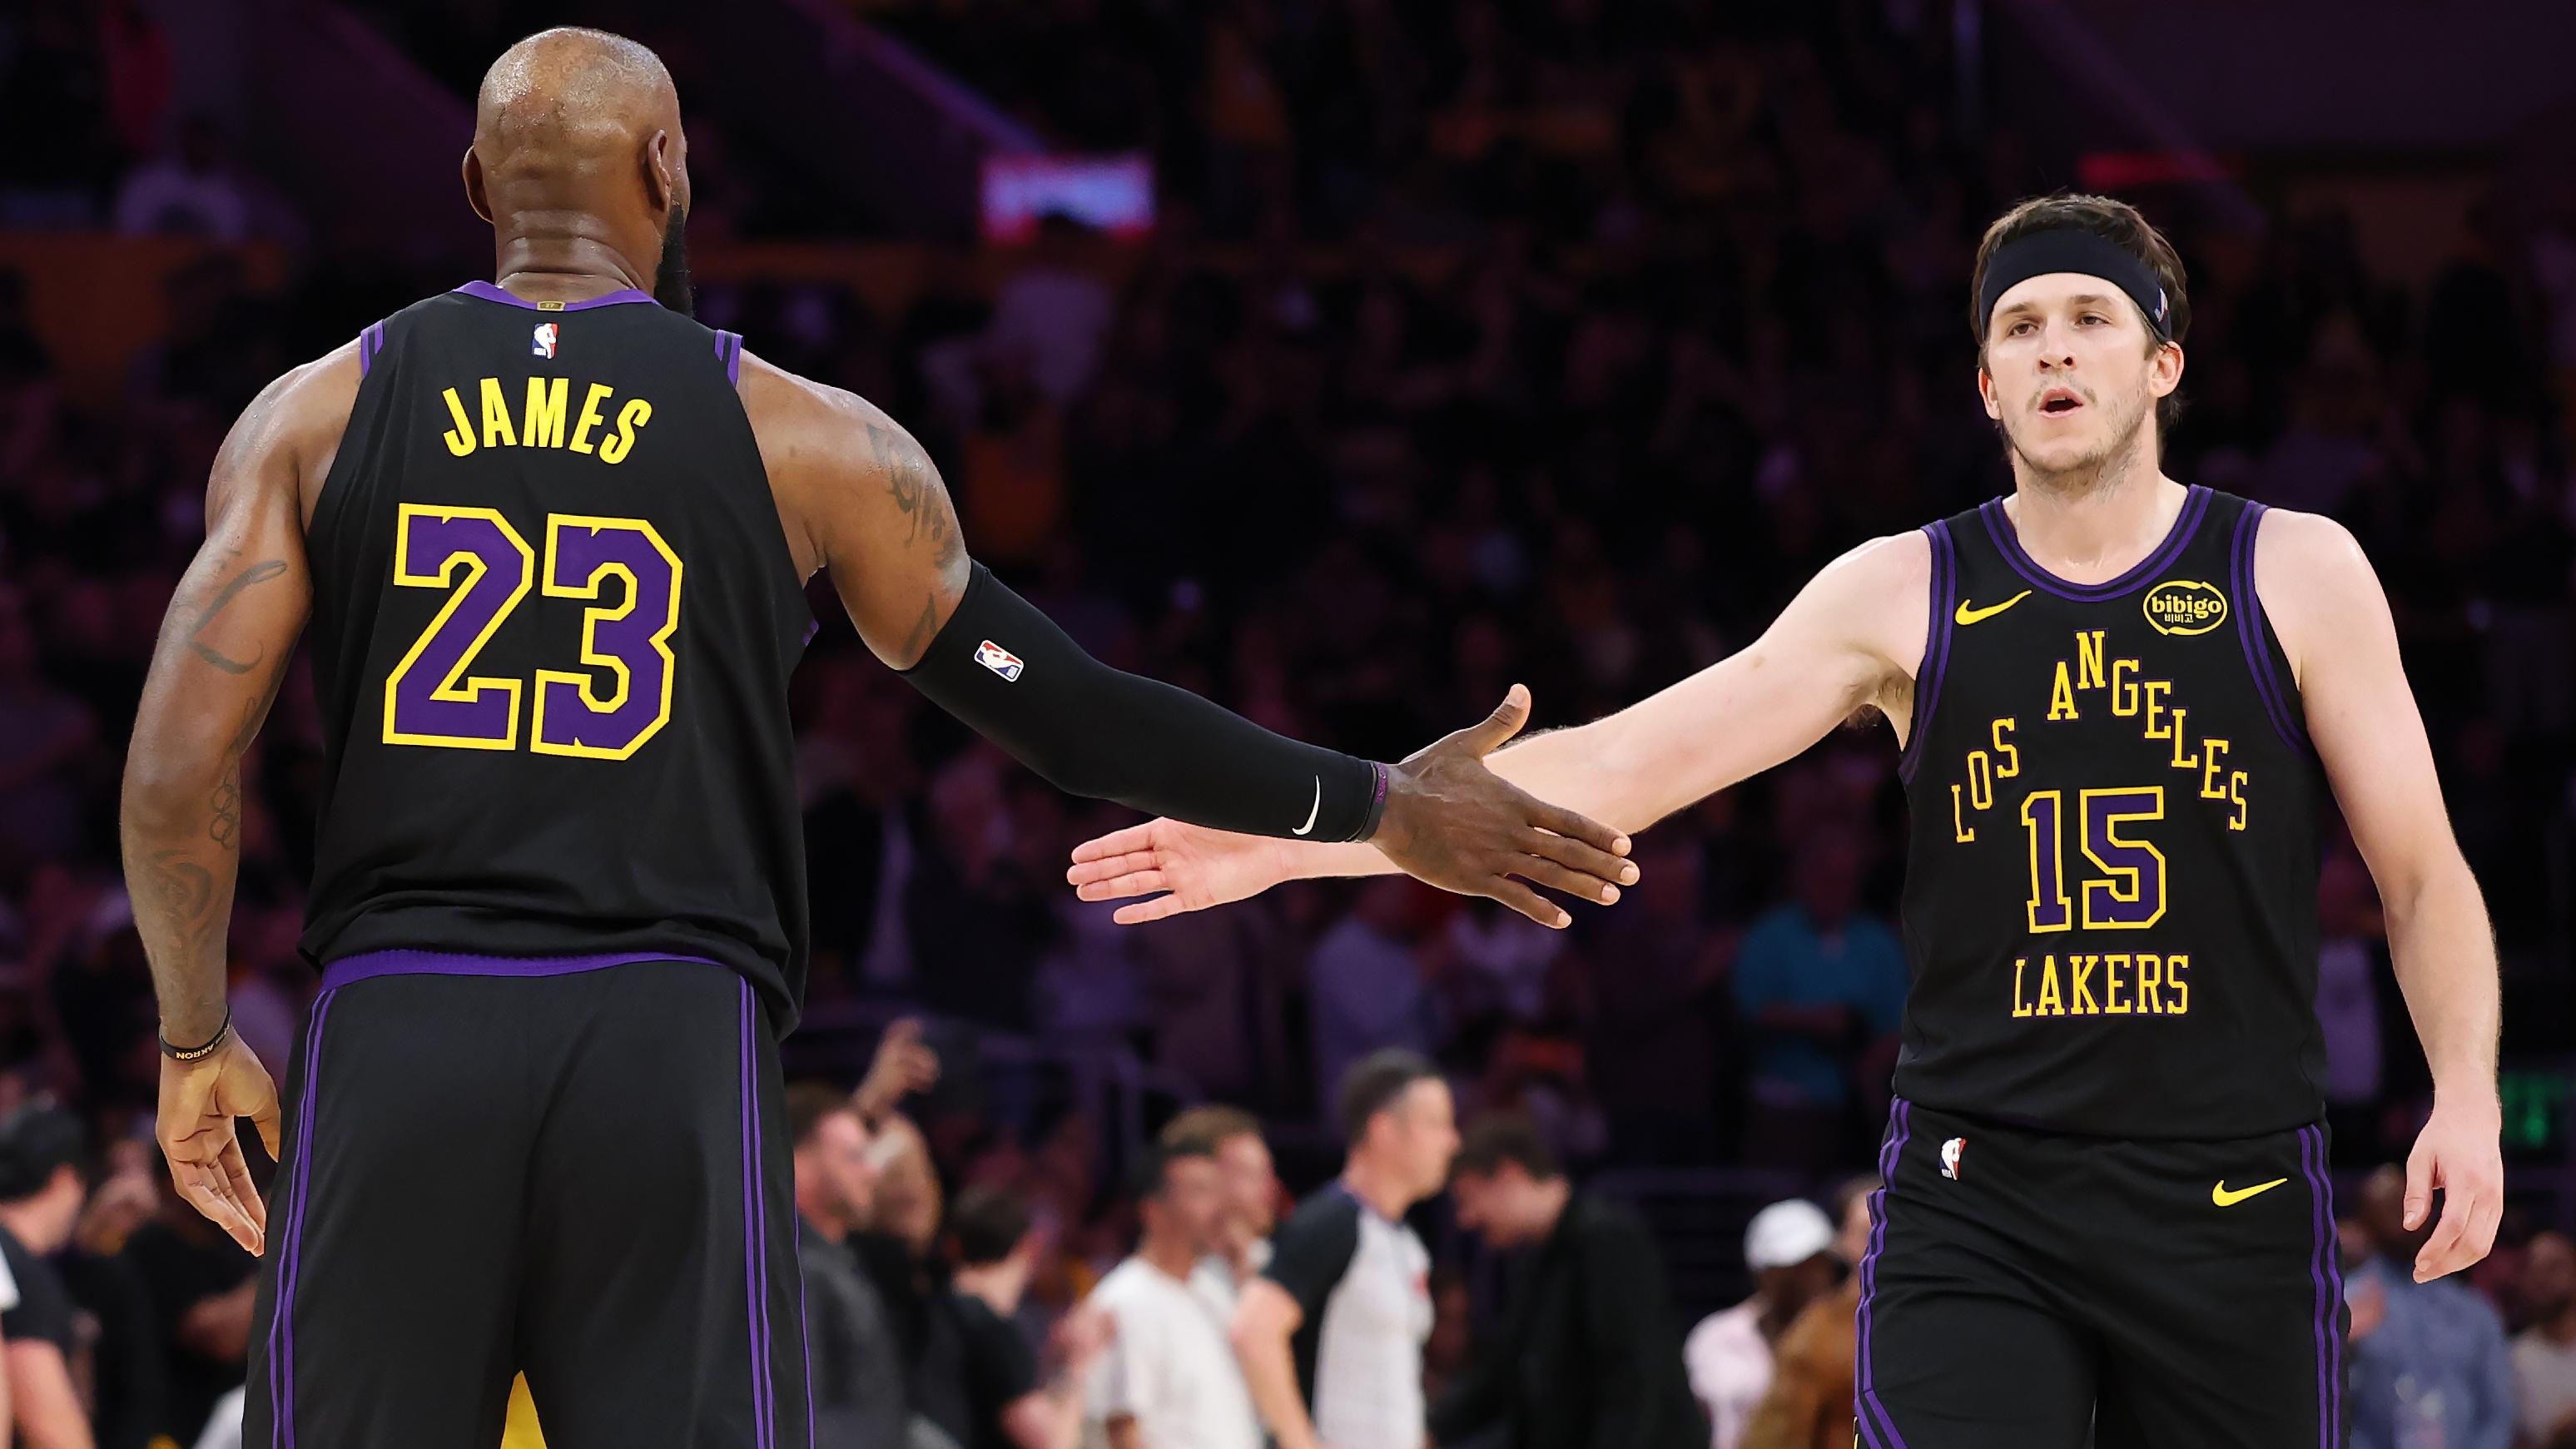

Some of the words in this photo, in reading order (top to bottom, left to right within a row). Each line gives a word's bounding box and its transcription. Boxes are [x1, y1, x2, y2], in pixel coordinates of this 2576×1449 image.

[442, 376, 653, 464] JAMES
[382, 503, 683, 761] 23
[2151, 593, 2223, 619] bibigo
[2164, 613, 2194, 623] 비비고
[1950, 716, 2021, 844] LOS
[2046, 629, 2249, 832] ANGELES
[2020, 786, 2167, 934] 15
[2011, 953, 2190, 1018] LAKERS
[176, 1043, 216, 1059] AKRON
